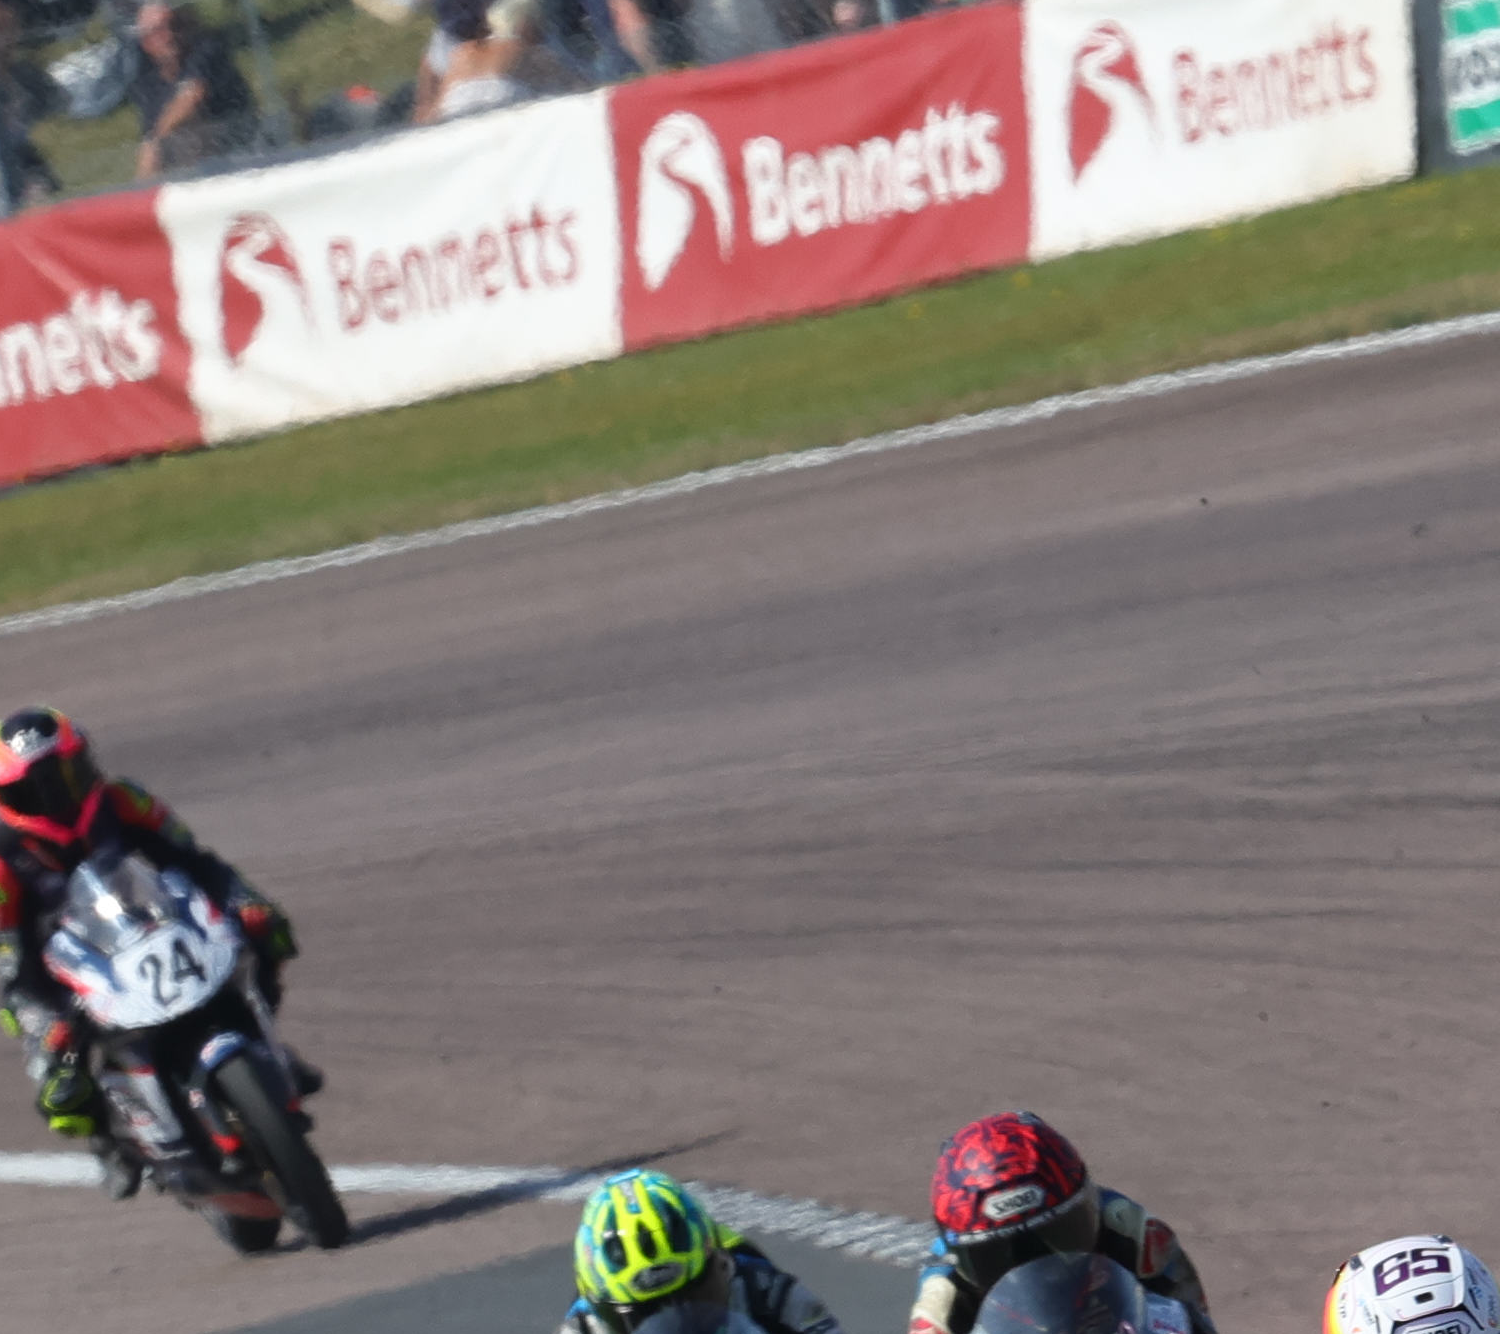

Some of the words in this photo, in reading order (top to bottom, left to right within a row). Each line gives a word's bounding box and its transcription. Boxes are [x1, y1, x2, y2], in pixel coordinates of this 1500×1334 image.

[1174, 17, 1381, 147] Bennetts
[742, 100, 1009, 249] Bennetts
[329, 201, 581, 333] Bennetts
[138, 939, 206, 1007] 24
[1373, 1247, 1450, 1295] 65
